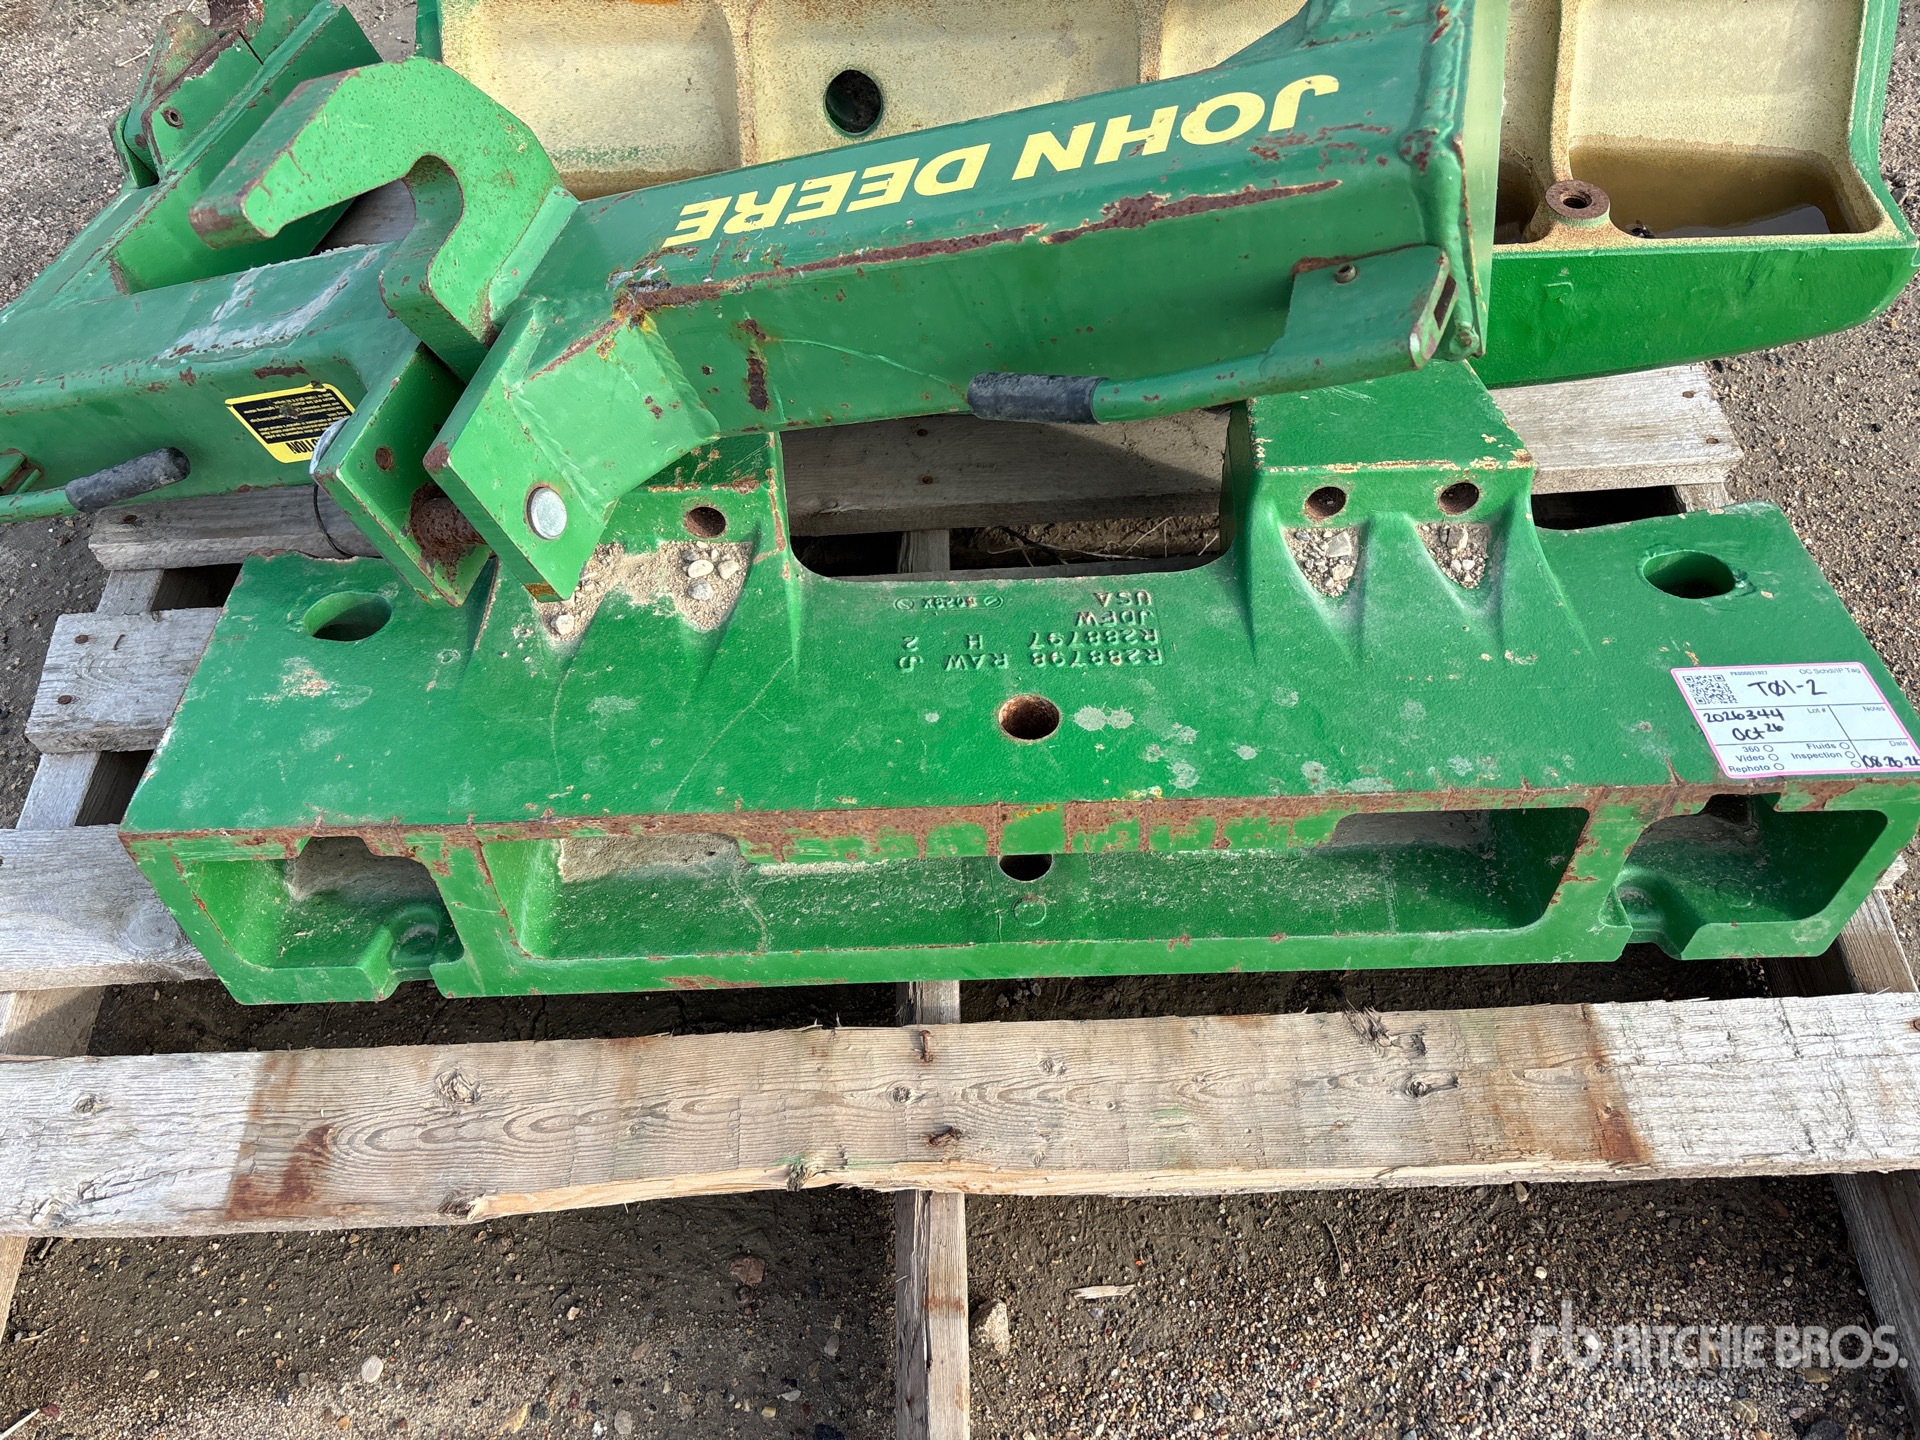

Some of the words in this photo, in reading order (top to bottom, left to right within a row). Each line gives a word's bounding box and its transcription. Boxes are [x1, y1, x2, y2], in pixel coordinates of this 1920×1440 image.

[1011, 74, 1340, 181] JOHN
[662, 143, 991, 247] DEERE
[1092, 590, 1153, 607] USA
[902, 635, 919, 651] 2
[965, 634, 984, 650] H
[1028, 628, 1159, 649] R288797
[944, 652, 1009, 672] RAW
[1845, 667, 1862, 675] Tag
[1703, 708, 1785, 723] 2026344
[1742, 745, 1761, 753] 360
[1806, 742, 1837, 750] Fluids
[1735, 754, 1765, 762] Video
[1791, 751, 1843, 760] Inspection
[1728, 764, 1771, 774] Rephoto
